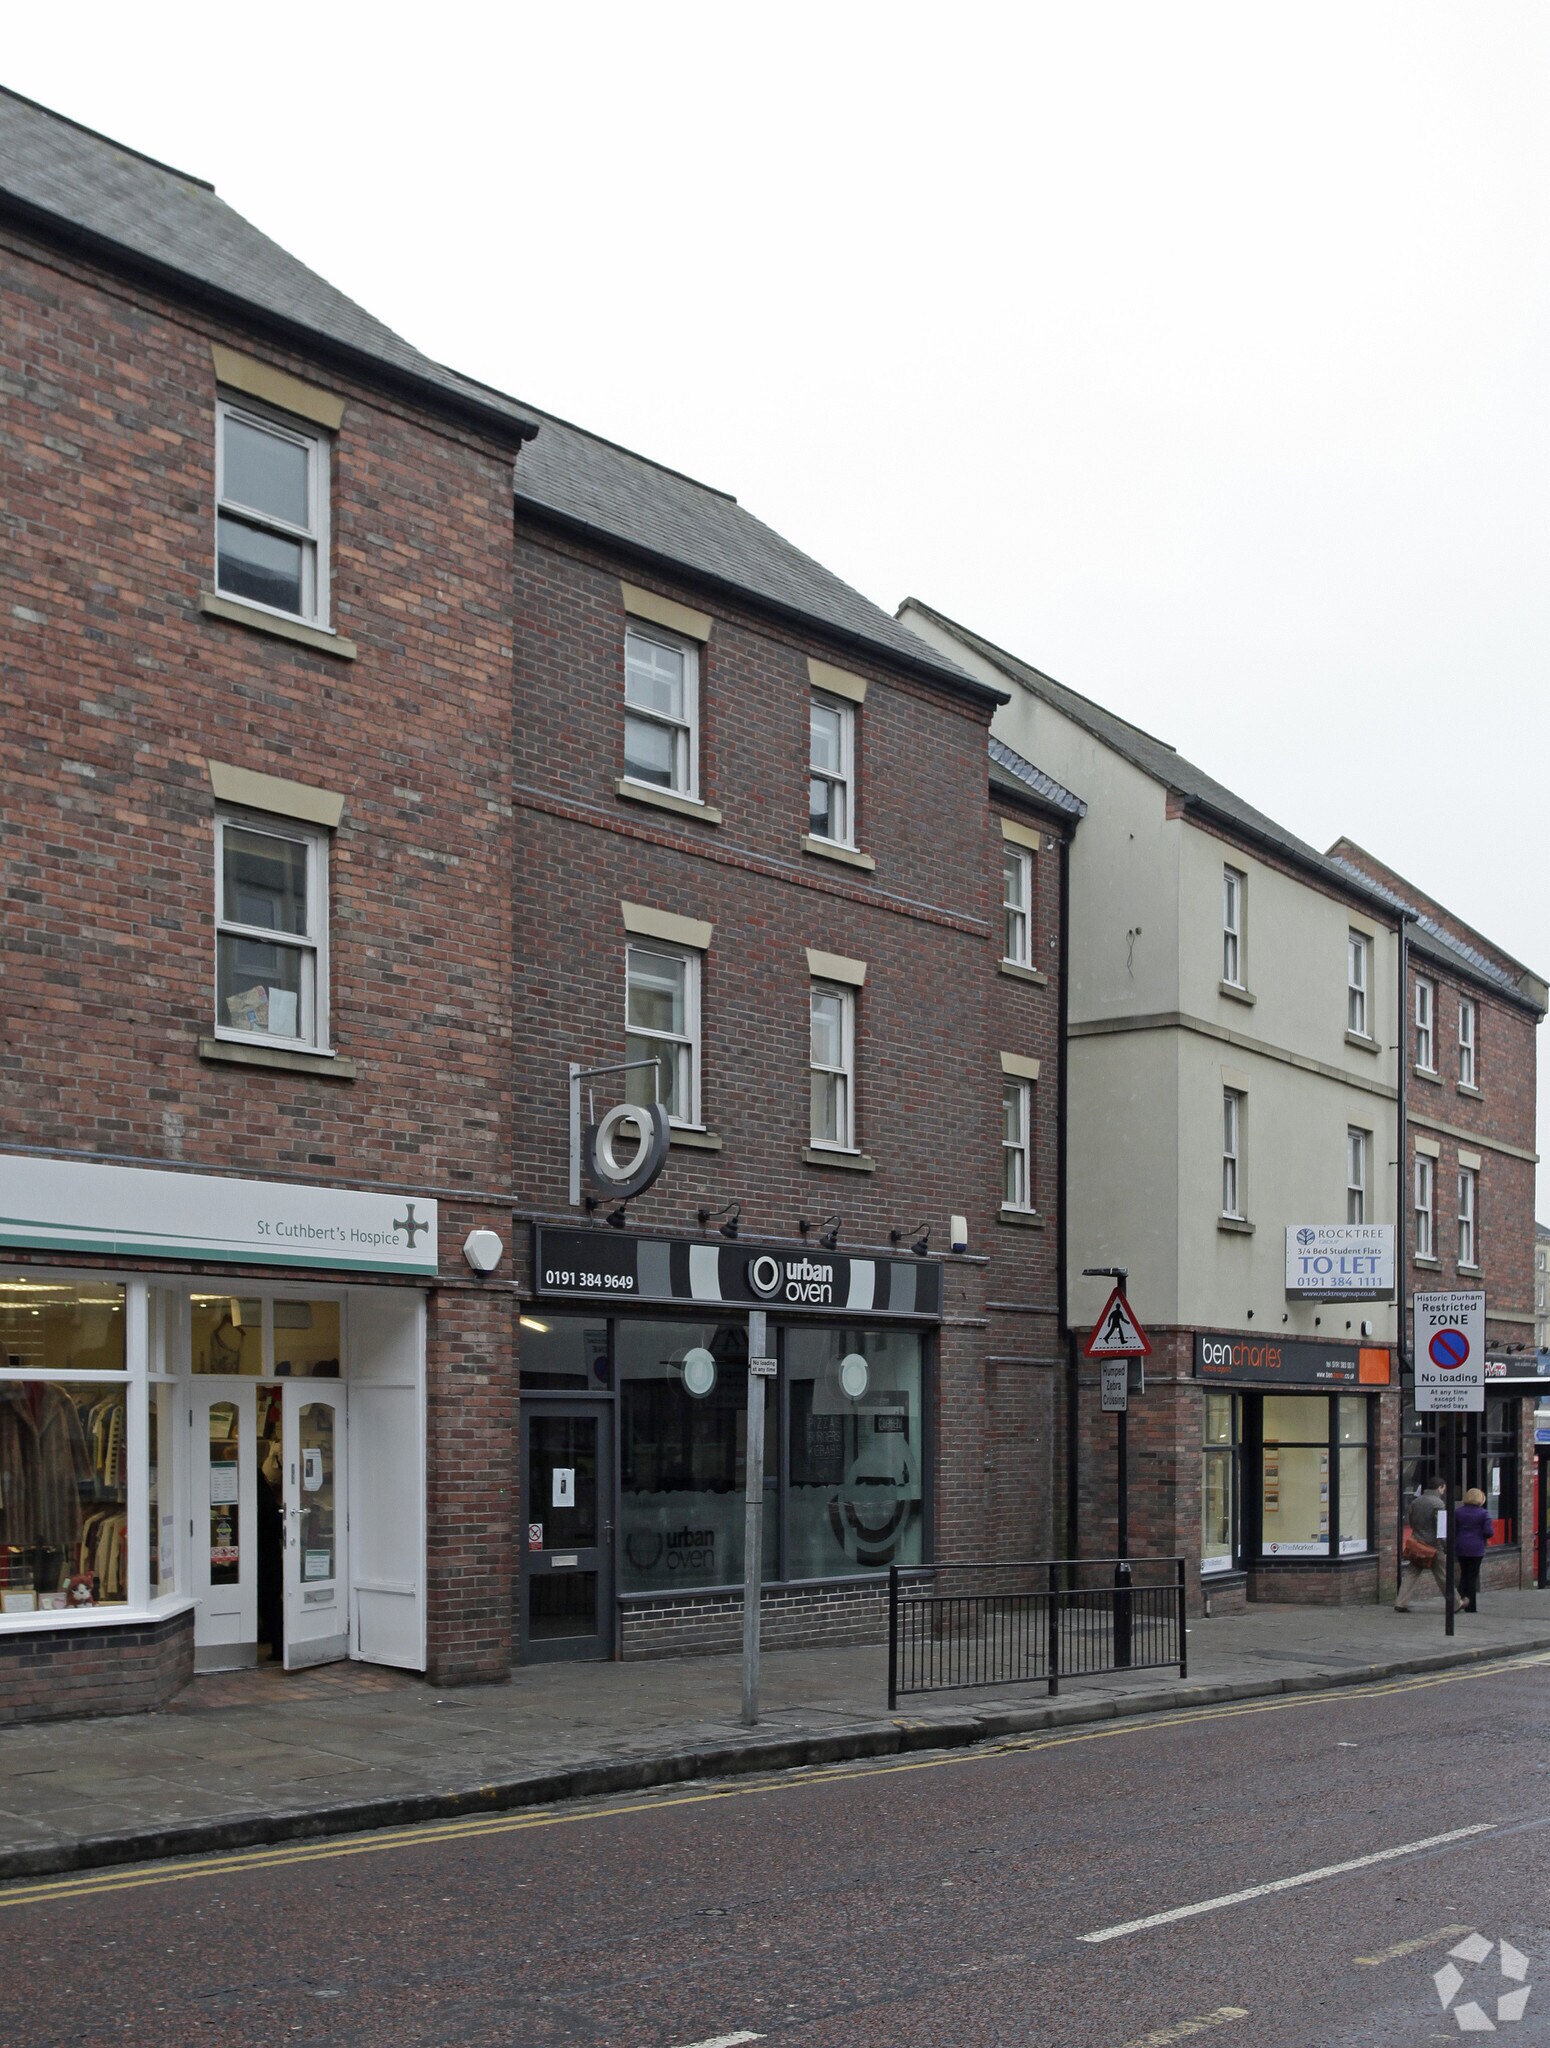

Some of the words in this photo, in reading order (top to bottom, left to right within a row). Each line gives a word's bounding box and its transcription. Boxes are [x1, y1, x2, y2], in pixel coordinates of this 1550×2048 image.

[257, 1220, 271, 1235] St
[275, 1221, 346, 1241] Cuthbert's
[350, 1228, 400, 1247] Hospice
[1318, 1229, 1384, 1239] ROCKTREE
[786, 1258, 834, 1283] urban
[1298, 1256, 1333, 1275] TO
[1340, 1256, 1381, 1275] LET
[546, 1270, 576, 1286] 0191
[579, 1272, 602, 1288] 384
[604, 1273, 634, 1290] 9649
[1297, 1276, 1325, 1287] 0191
[1330, 1276, 1353, 1287] 384
[1358, 1276, 1383, 1287] 1111
[785, 1282, 833, 1303] oven
[1416, 1294, 1448, 1302] Historic
[1450, 1293, 1483, 1301] Durham
[1422, 1302, 1477, 1312] Restricted
[1429, 1314, 1469, 1326] ZONE
[1103, 1365, 1125, 1377] Humped
[1421, 1374, 1436, 1382] No
[1439, 1373, 1478, 1383] loading
[1106, 1380, 1122, 1391] Zebra
[1103, 1394, 1125, 1407] Crossing
[667, 1526, 715, 1548] urban
[667, 1549, 715, 1569] oven
